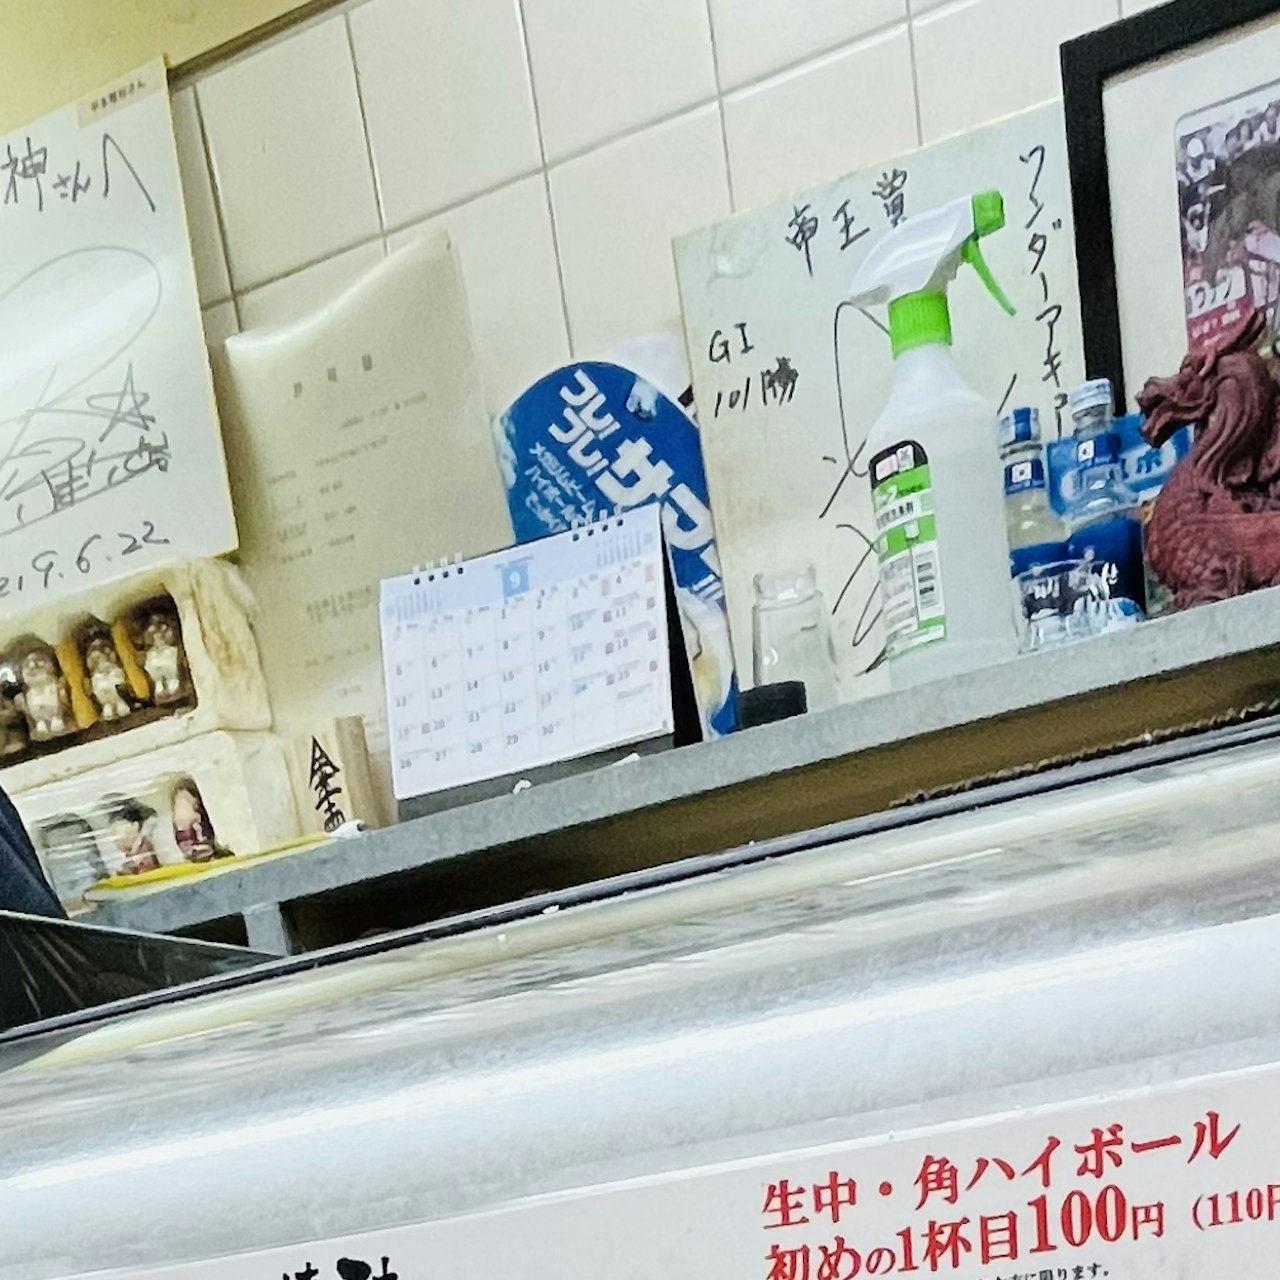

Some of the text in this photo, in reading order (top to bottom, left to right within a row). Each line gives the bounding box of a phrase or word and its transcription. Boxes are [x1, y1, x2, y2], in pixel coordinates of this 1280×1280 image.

[761, 1111, 1241, 1231] 生中・角ハイボール
